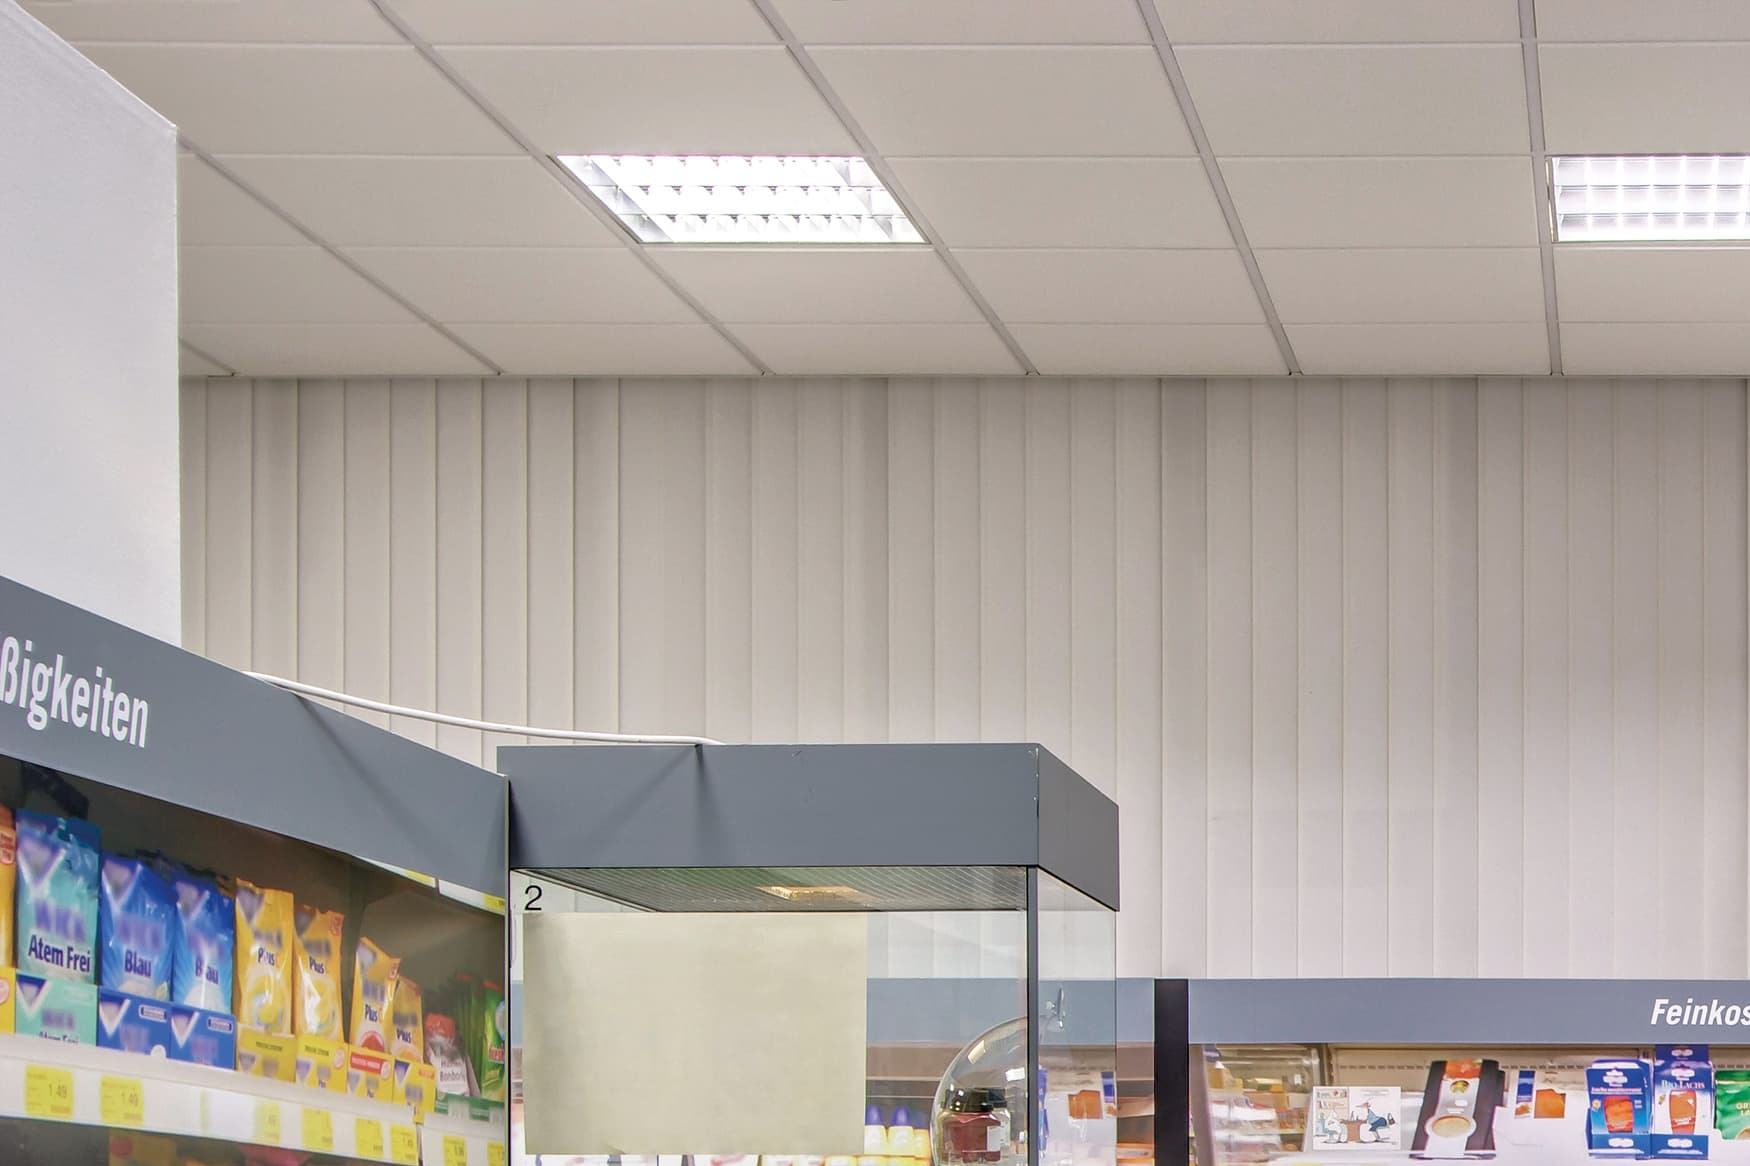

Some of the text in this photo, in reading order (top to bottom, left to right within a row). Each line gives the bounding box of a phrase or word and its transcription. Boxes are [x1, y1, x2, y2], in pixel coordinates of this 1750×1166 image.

[523, 884, 543, 912] 2
[28, 934, 91, 973] Atem Frei
[124, 949, 152, 977] Blau
[195, 957, 219, 985] Bau
